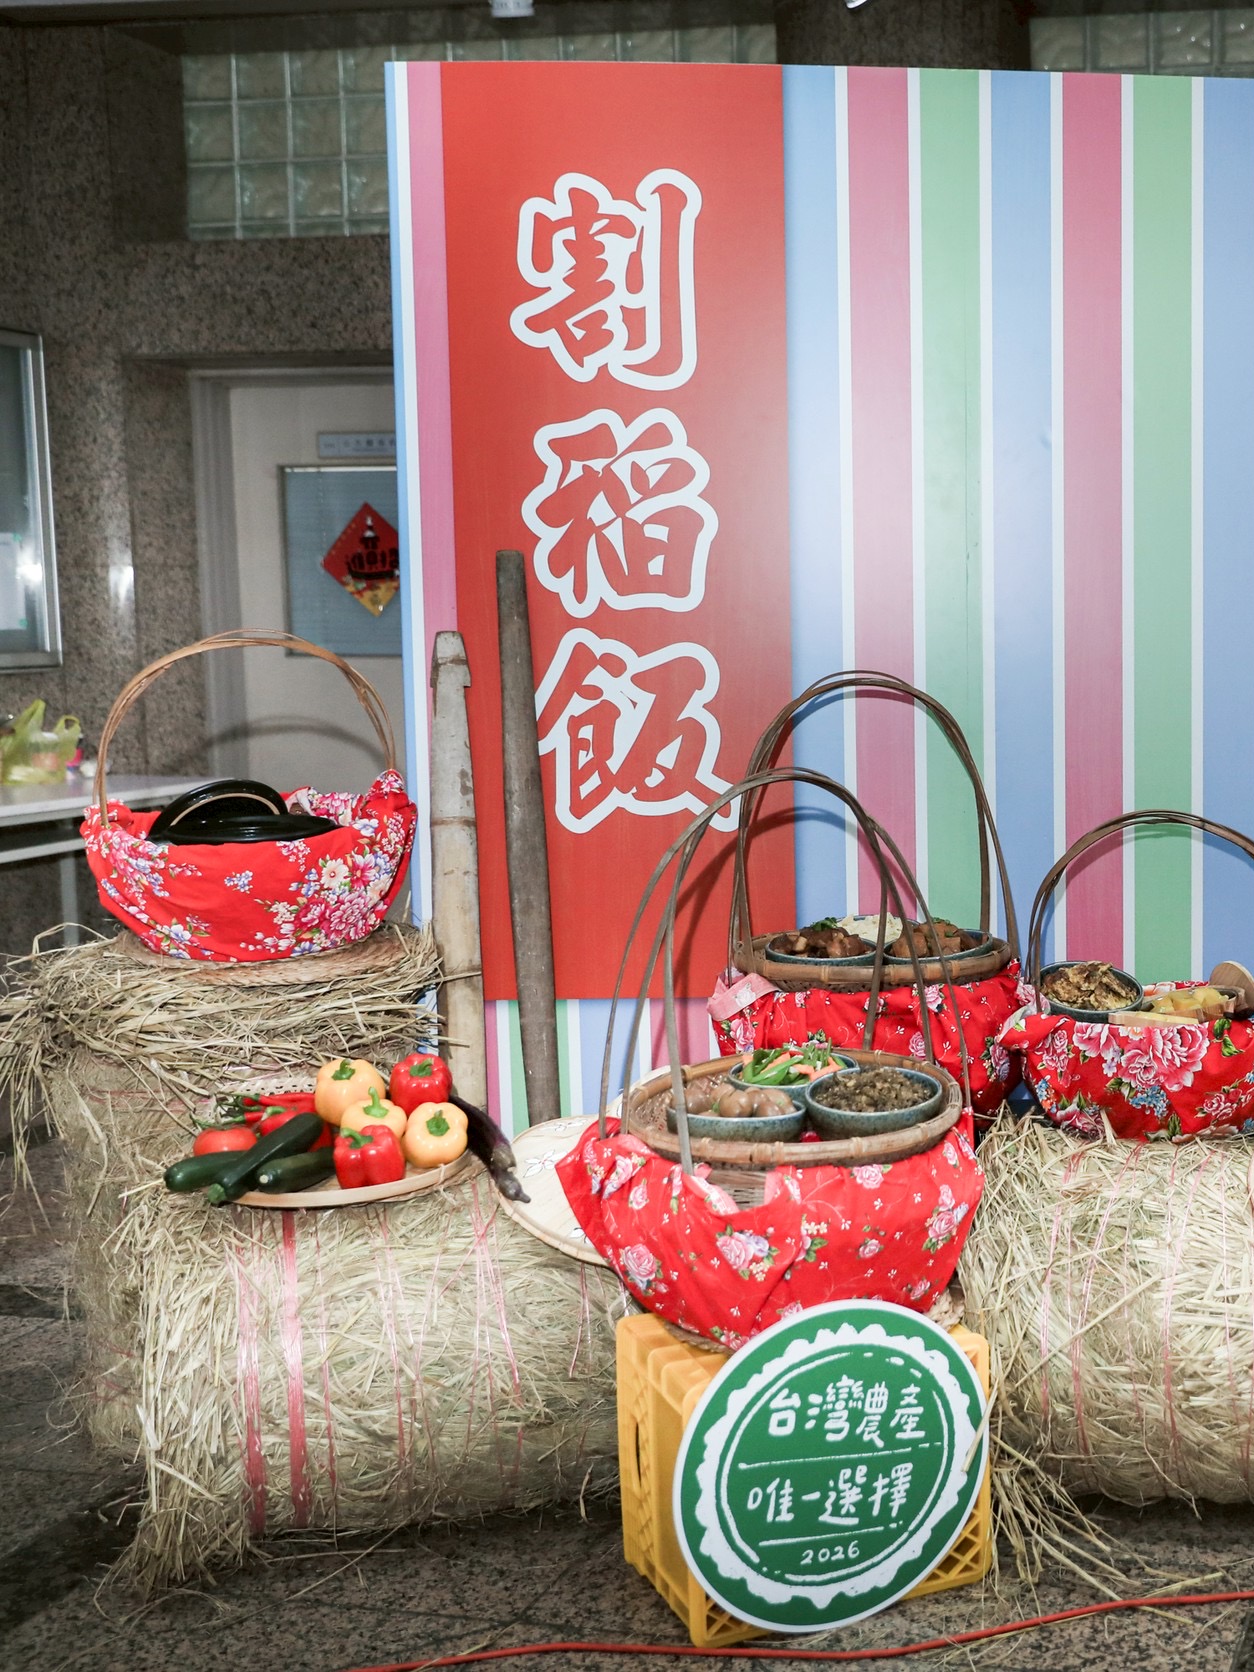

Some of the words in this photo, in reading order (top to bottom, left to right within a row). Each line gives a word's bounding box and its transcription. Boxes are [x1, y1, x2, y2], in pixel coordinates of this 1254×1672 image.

[767, 1374, 926, 1448] 台灣農產
[746, 1462, 914, 1526] 唯一選擇
[800, 1540, 860, 1566] 2026
